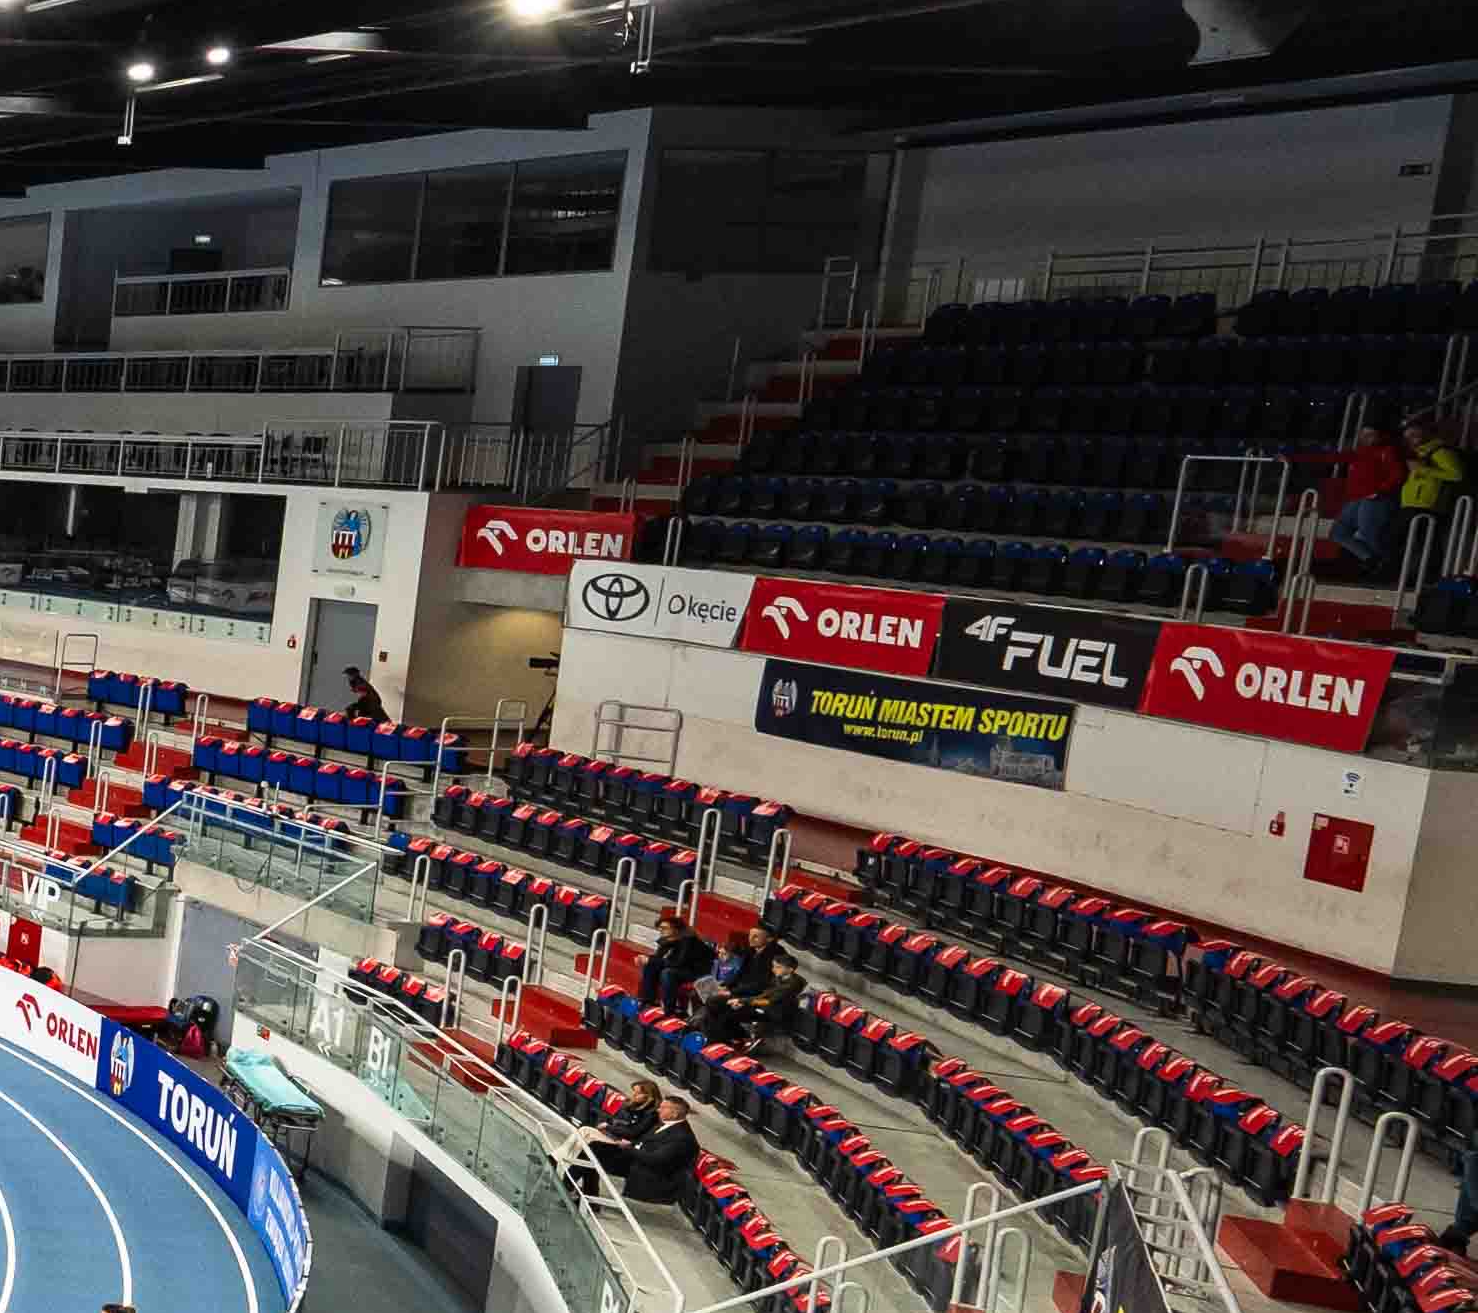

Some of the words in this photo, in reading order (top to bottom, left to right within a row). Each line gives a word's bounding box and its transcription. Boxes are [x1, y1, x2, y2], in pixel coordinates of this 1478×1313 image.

[526, 527, 624, 558] ORLEN
[668, 594, 737, 624] Okęcie
[817, 607, 925, 649] ORLEN
[965, 614, 1015, 643] 4F
[1002, 632, 1129, 689] FUEL
[1234, 662, 1365, 717] ORLEN
[810, 689, 877, 722] TORUŃ
[878, 699, 974, 734] MIASTEM
[977, 707, 1068, 743] SPORTU
[843, 721, 924, 746] www.torun.pl
[21, 875, 62, 905] VIP
[46, 1013, 99, 1059] ORLEN
[367, 1025, 393, 1074] B1
[157, 1070, 239, 1180] TORUŃ
